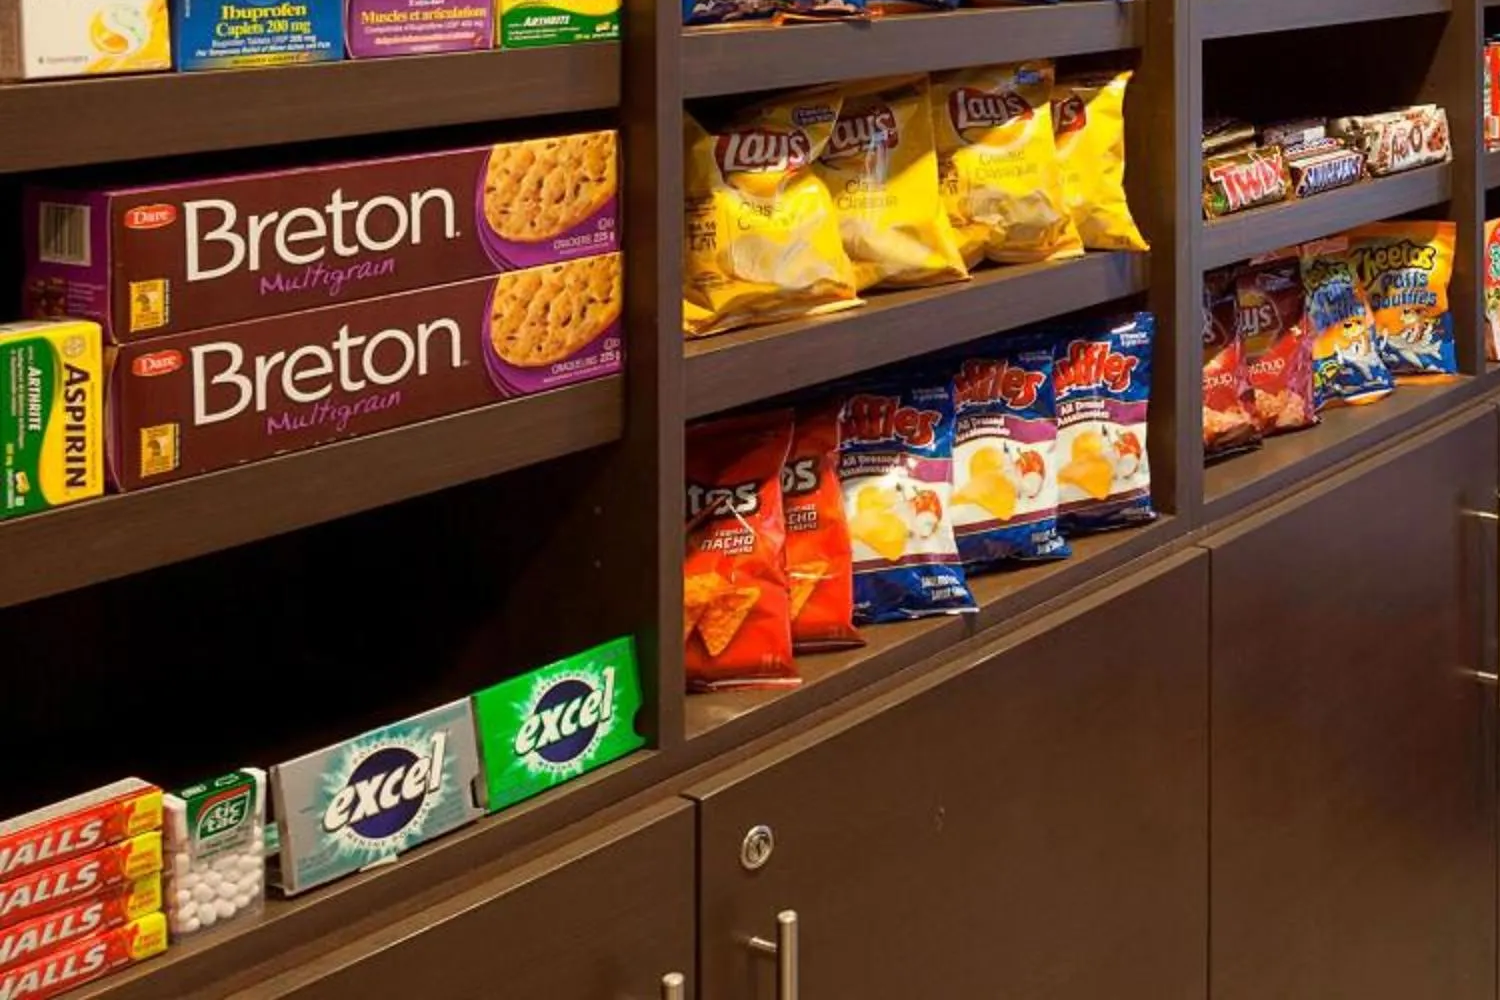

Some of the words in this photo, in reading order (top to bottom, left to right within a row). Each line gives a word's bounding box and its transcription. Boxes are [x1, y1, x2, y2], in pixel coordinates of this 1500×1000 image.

[215, 22, 264, 38] Caplets
[267, 19, 288, 34] 200
[290, 21, 311, 35] mg
[221, 1, 307, 22] Ibuprofen
[361, 9, 408, 24] Muscles
[956, 88, 1023, 130] Lay's
[723, 131, 806, 173] Lay's
[132, 207, 169, 225] Dare
[183, 186, 457, 282] Breton
[259, 256, 396, 297] Multigrain
[141, 353, 177, 374] Dare
[190, 317, 461, 426] Breton
[27, 365, 43, 432] ARTHRITE
[266, 391, 401, 434] Multigrain
[63, 363, 90, 488] ASPIRIN
[788, 511, 817, 525] CHO
[701, 535, 754, 551] NACHO
[515, 666, 616, 755] excel
[323, 731, 448, 832] excel
[205, 813, 241, 834] tac
[213, 799, 241, 822] tic
[0, 860, 100, 917] ALLS
